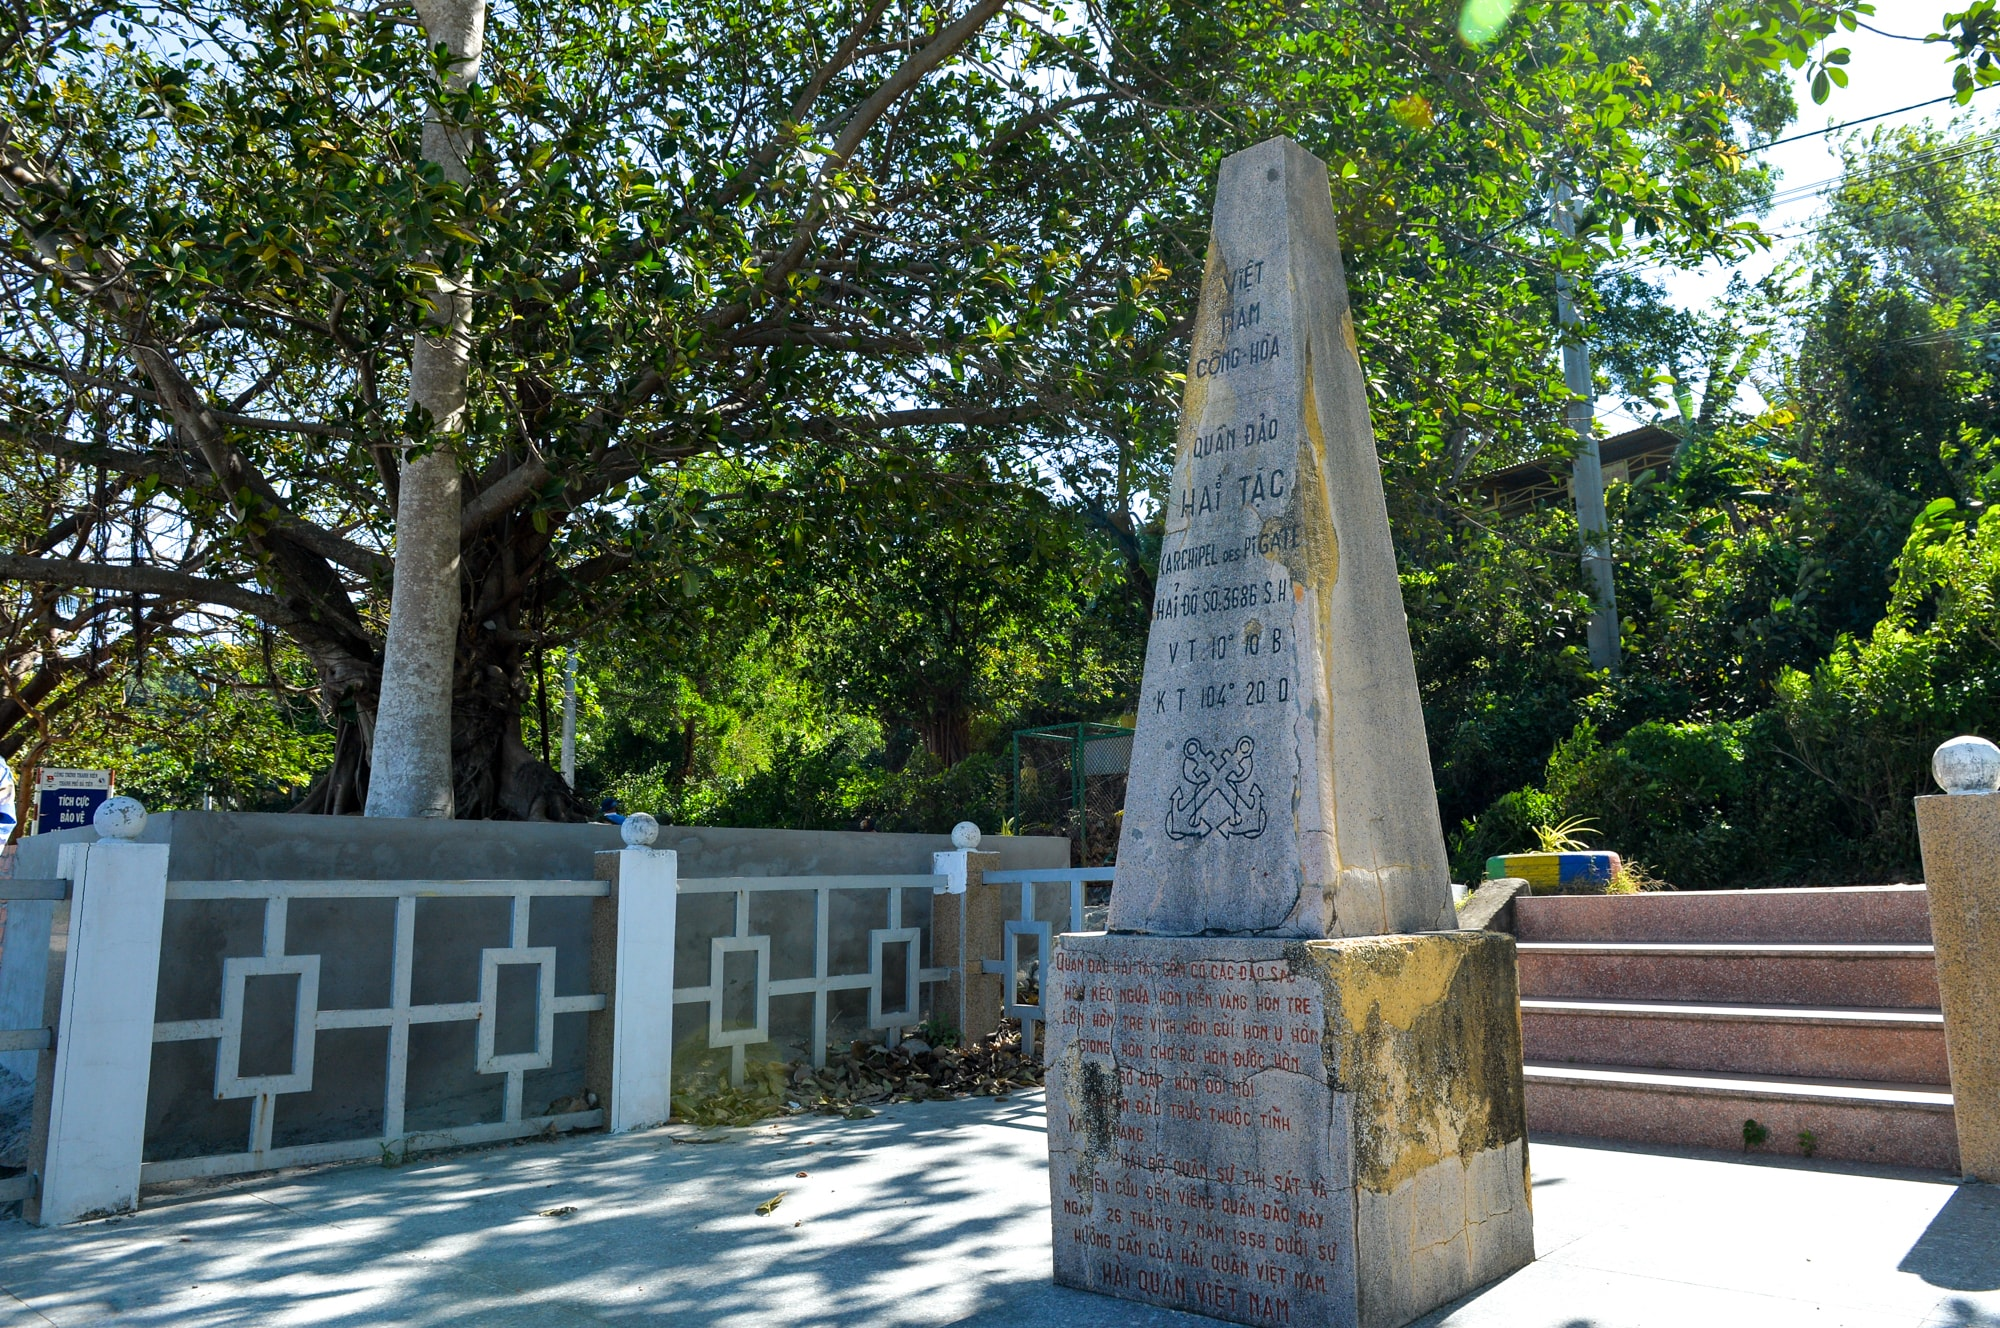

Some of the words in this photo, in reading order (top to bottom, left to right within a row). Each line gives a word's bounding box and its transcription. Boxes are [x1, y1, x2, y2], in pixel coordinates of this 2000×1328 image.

[1244, 413, 1278, 448] ĐẢO
[58, 794, 75, 807] TÍCH
[75, 795, 90, 808] CỰC
[60, 809, 75, 823] BẢO
[76, 810, 85, 824] VỆ
[1287, 997, 1311, 1014] TRE
[1122, 1015, 1143, 1031] TRE
[1106, 1208, 1122, 1224] 26
[1181, 1220, 1188, 1236] 7
[1233, 1230, 1266, 1249] 1958
[1249, 1291, 1290, 1324] NAM
